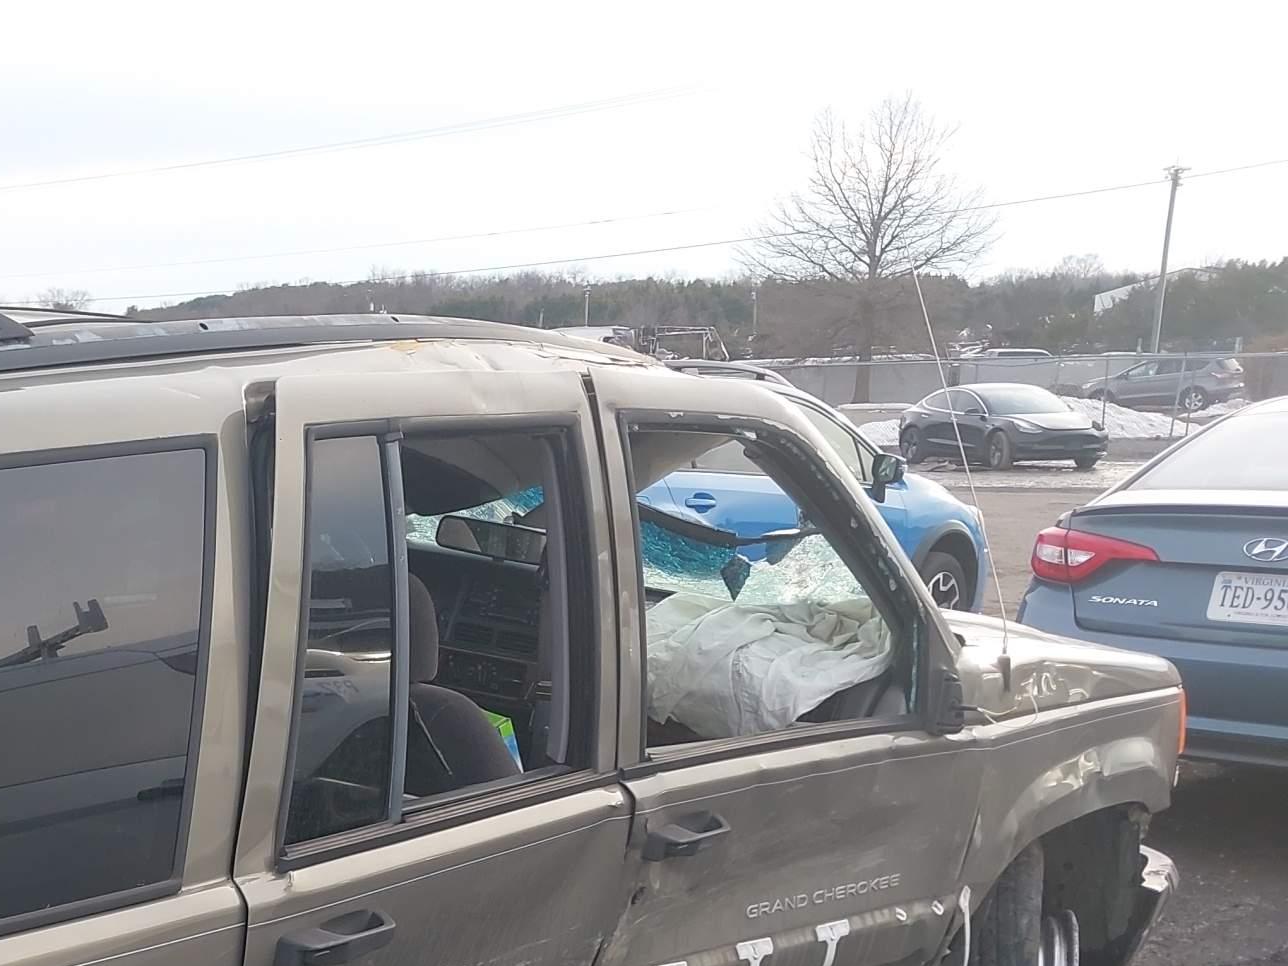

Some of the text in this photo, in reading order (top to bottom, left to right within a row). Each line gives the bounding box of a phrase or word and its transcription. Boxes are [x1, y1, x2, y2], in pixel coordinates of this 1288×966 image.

[1244, 576, 1288, 588] VIRGINI
[1087, 595, 1159, 607] SONATA
[1220, 584, 1288, 611] TED-95
[746, 873, 901, 918] GRAND CHEROKEE
